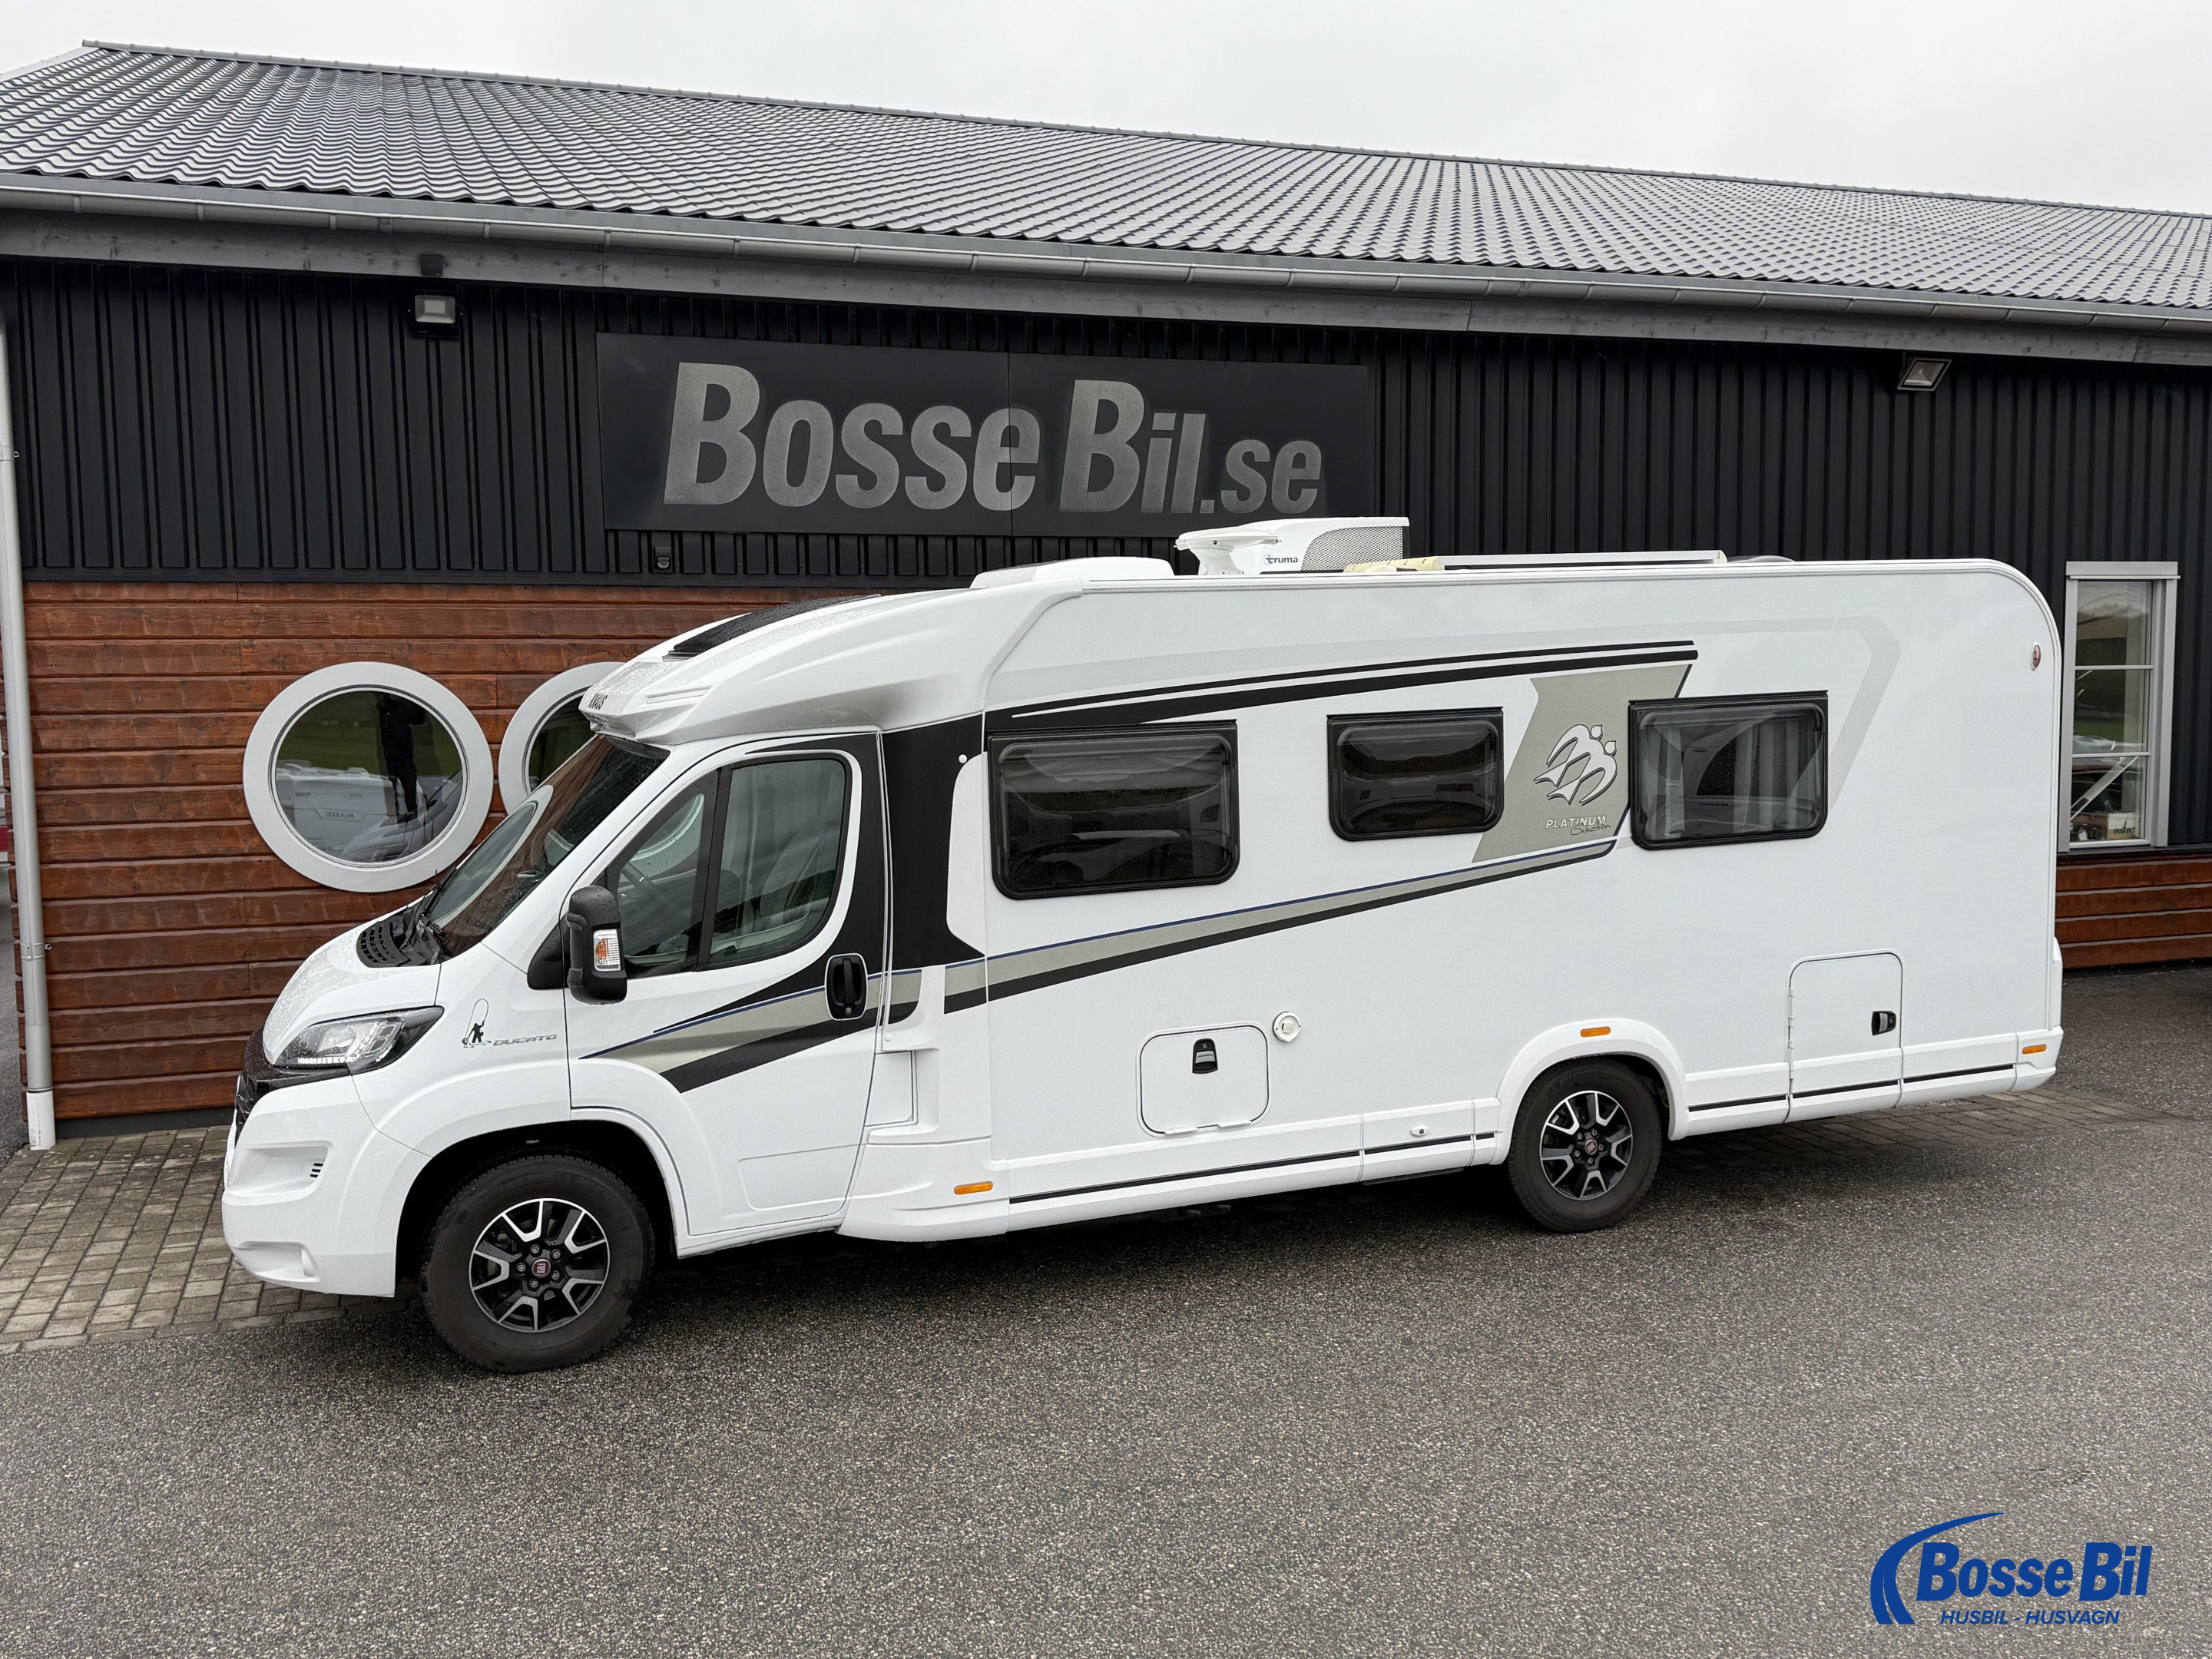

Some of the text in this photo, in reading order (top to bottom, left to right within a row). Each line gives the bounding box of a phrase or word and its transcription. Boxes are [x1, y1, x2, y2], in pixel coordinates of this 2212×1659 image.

[663, 362, 1323, 515] Bosse Bil.se
[1264, 554, 1298, 564] truma
[1545, 815, 1607, 830] PLATINUM
[1570, 823, 1611, 836] Selection
[492, 1034, 558, 1046] DUCATO
